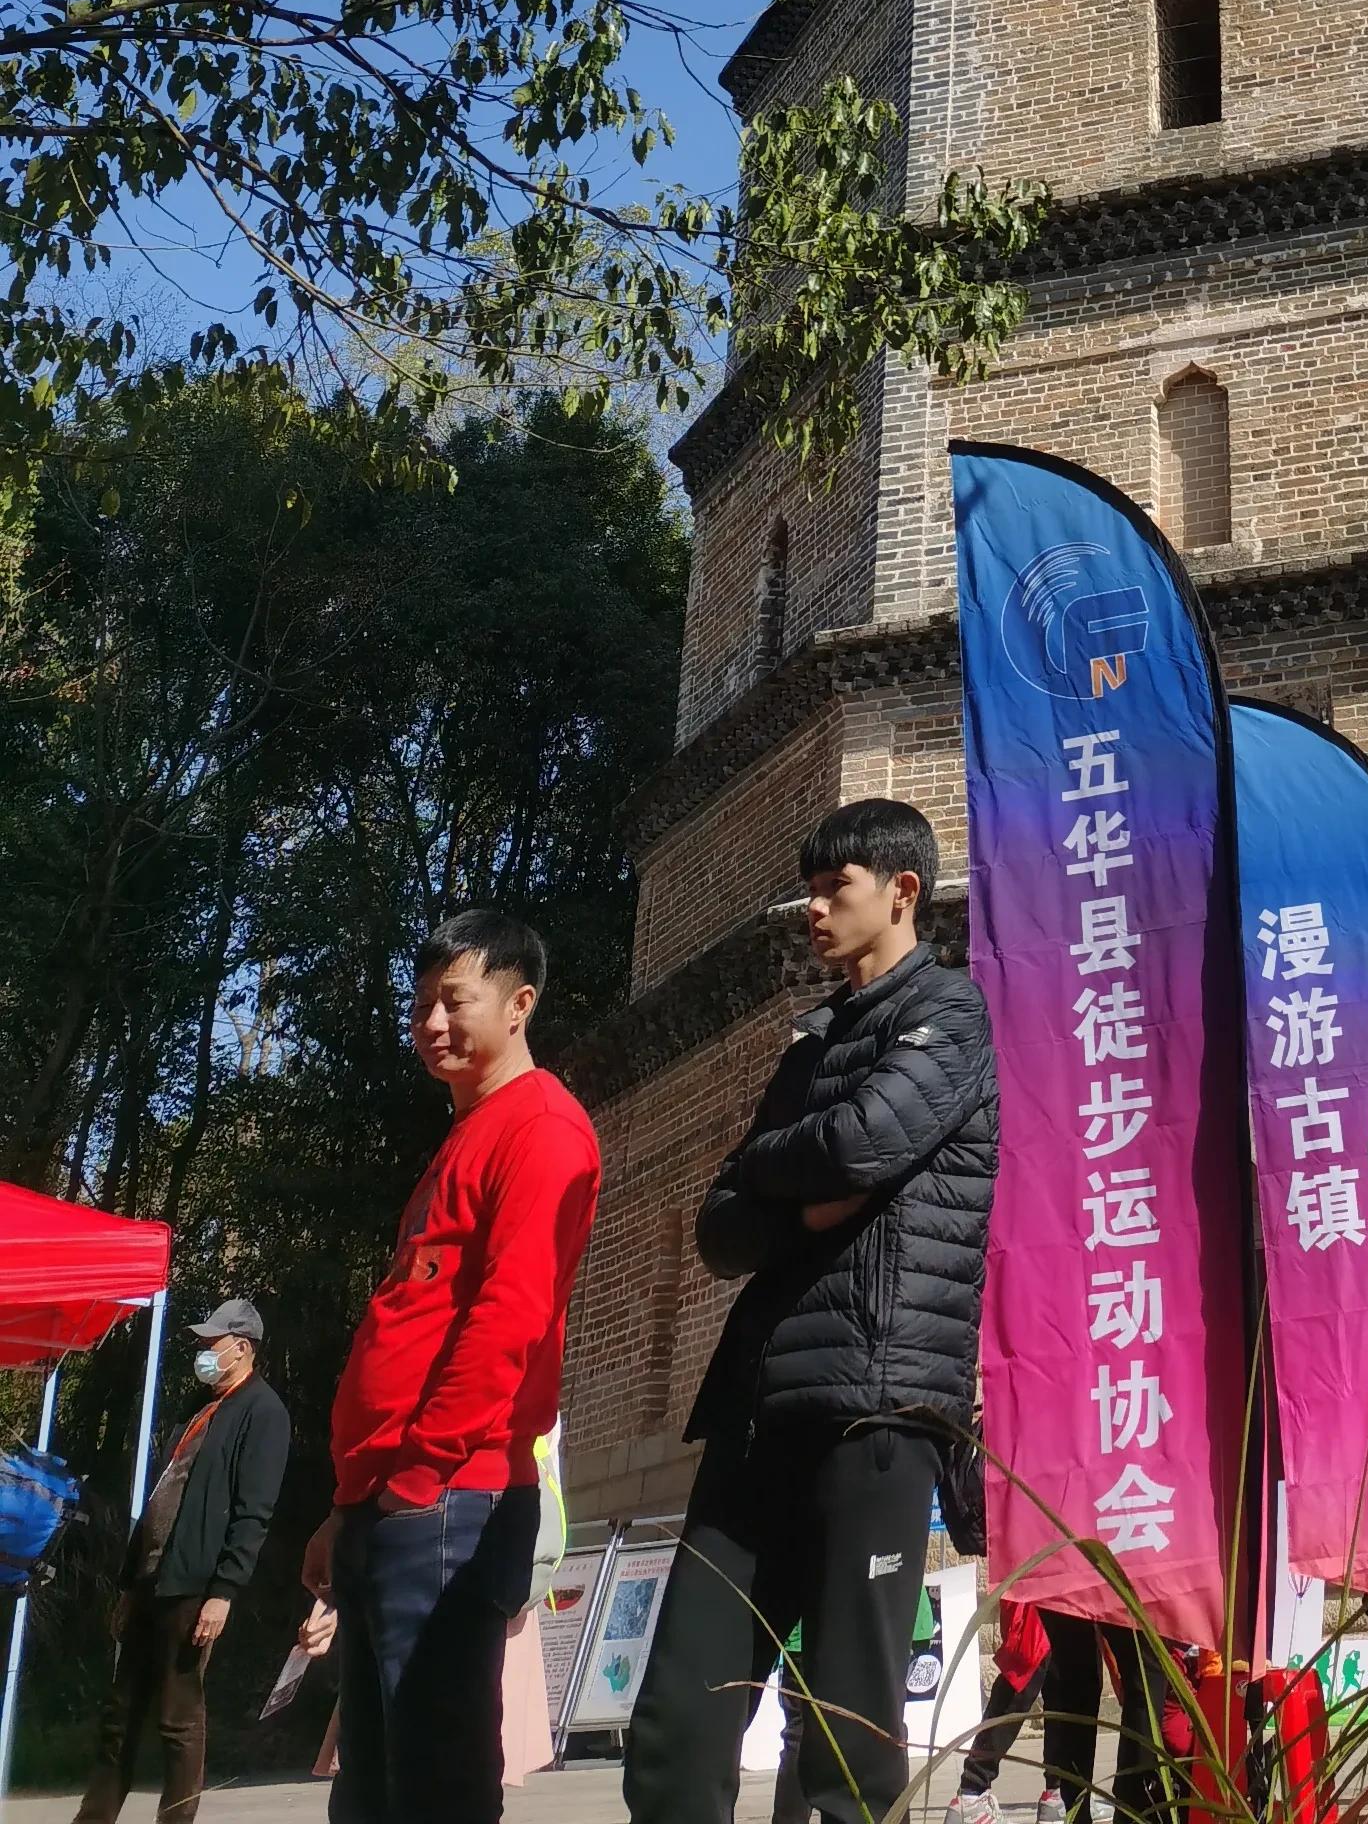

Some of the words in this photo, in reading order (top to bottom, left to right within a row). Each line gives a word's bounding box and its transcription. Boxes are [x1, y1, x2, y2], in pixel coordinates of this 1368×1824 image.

[1061, 729, 1175, 1555] 五华县徒步运动协会
[1257, 901, 1367, 1252] 漫游古镇
